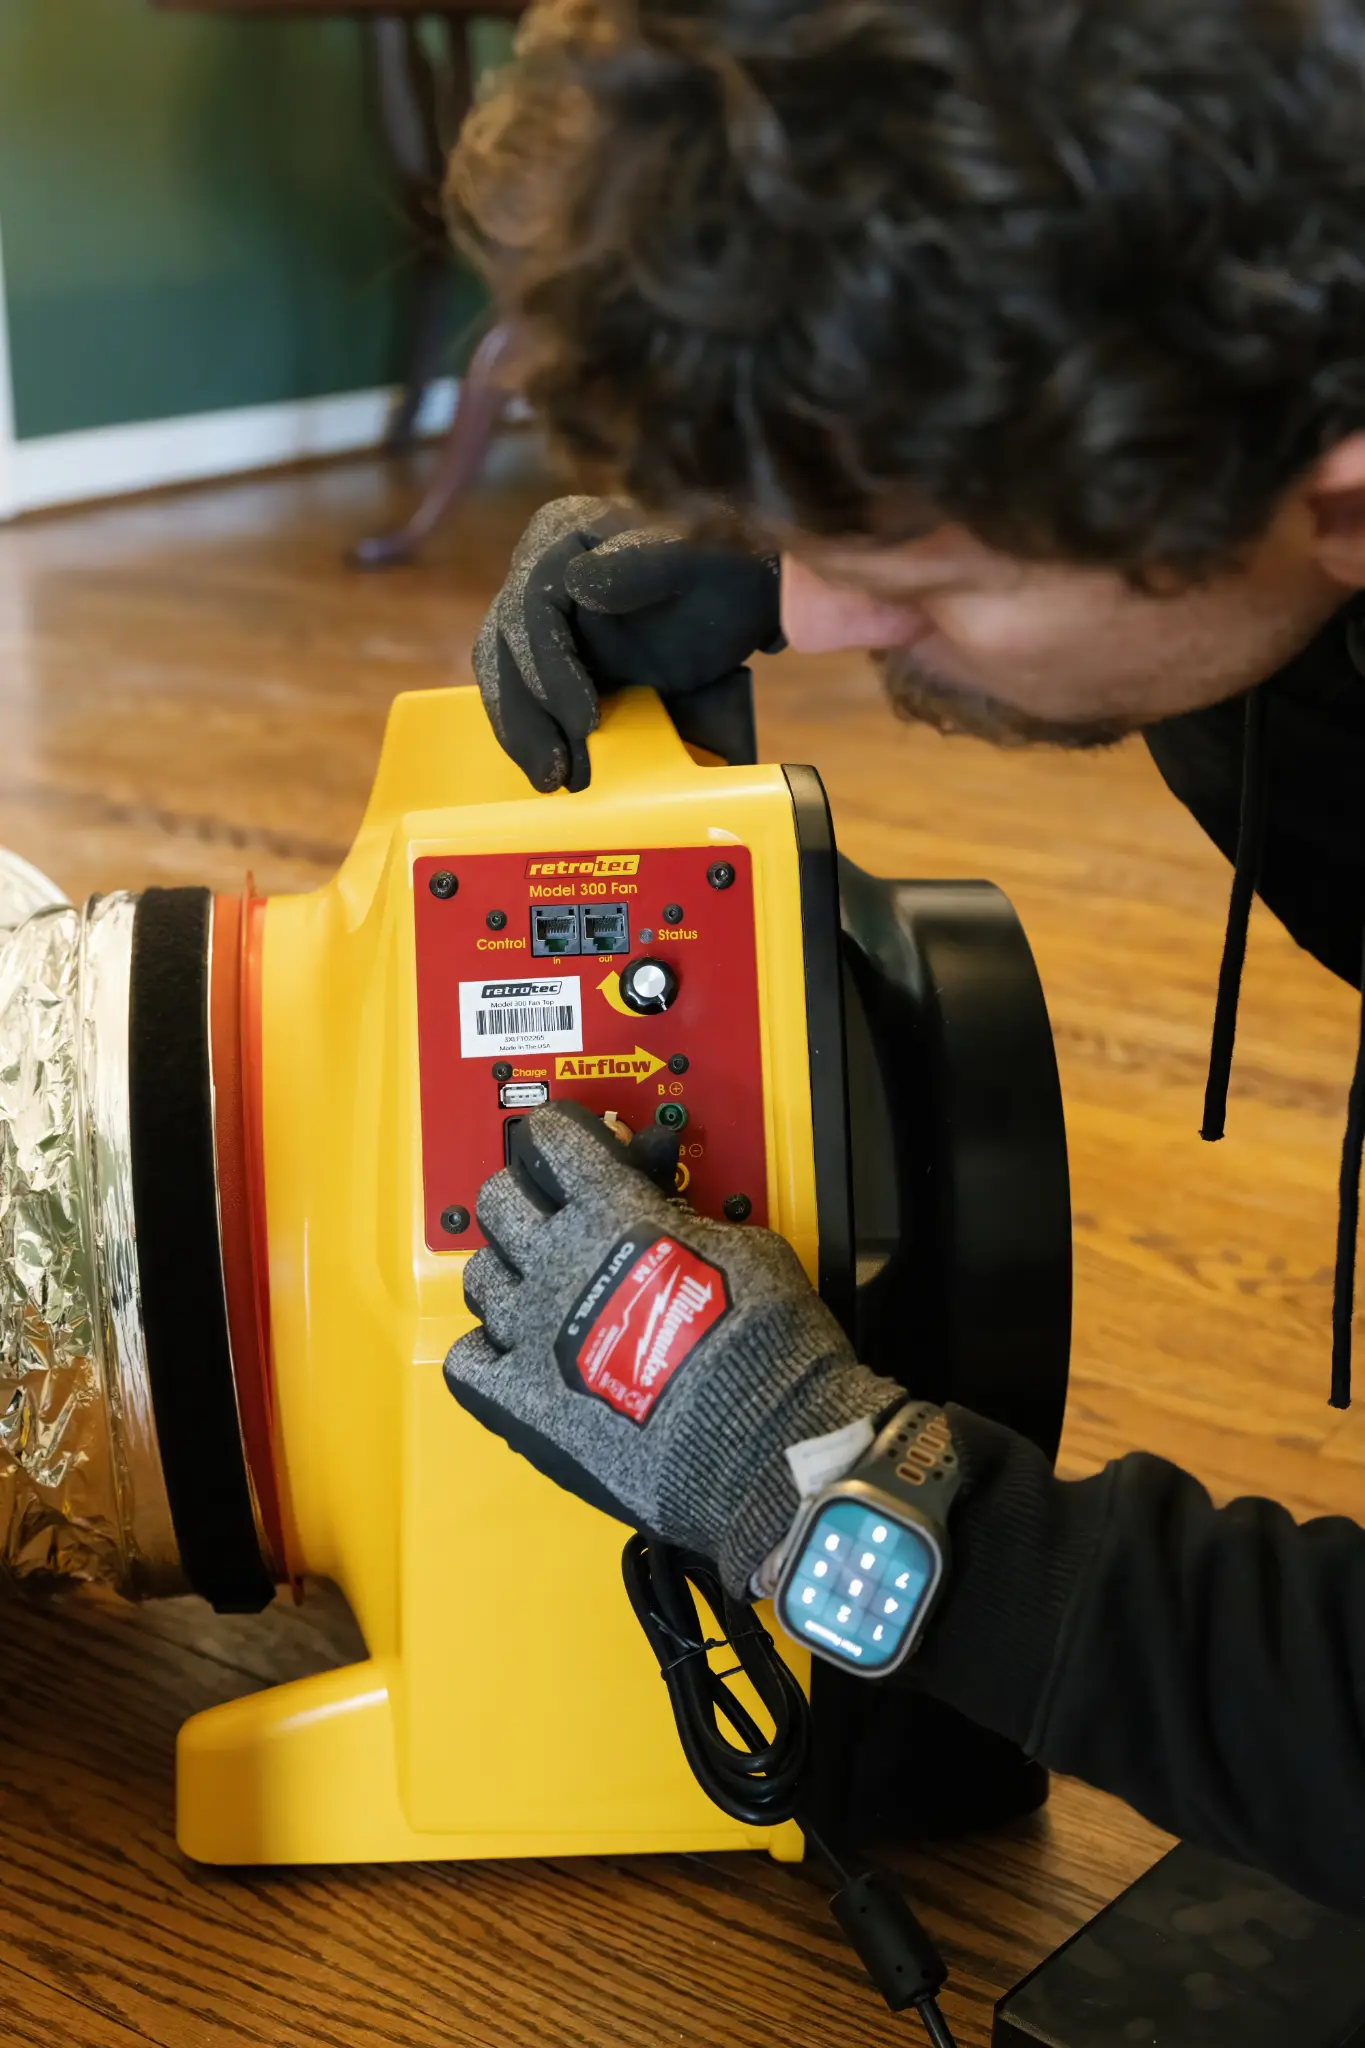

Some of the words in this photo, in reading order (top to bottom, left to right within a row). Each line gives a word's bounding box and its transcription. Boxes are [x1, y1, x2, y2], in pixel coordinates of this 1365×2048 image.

[529, 858, 636, 876] retrotec
[529, 884, 576, 898] Model
[580, 882, 607, 896] 300
[611, 882, 638, 895] Fan
[658, 929, 698, 941] Status
[476, 937, 527, 951] Control
[599, 954, 613, 963] out
[485, 983, 558, 996] retrotec
[512, 1068, 548, 1078] Charge
[560, 1059, 652, 1077] Airflow
[657, 1083, 666, 1096] B
[607, 1241, 636, 1278] CUT
[574, 1274, 612, 1320] LEVEL
[567, 1322, 581, 1336] 3
[640, 1275, 712, 1387] Milwaukee
